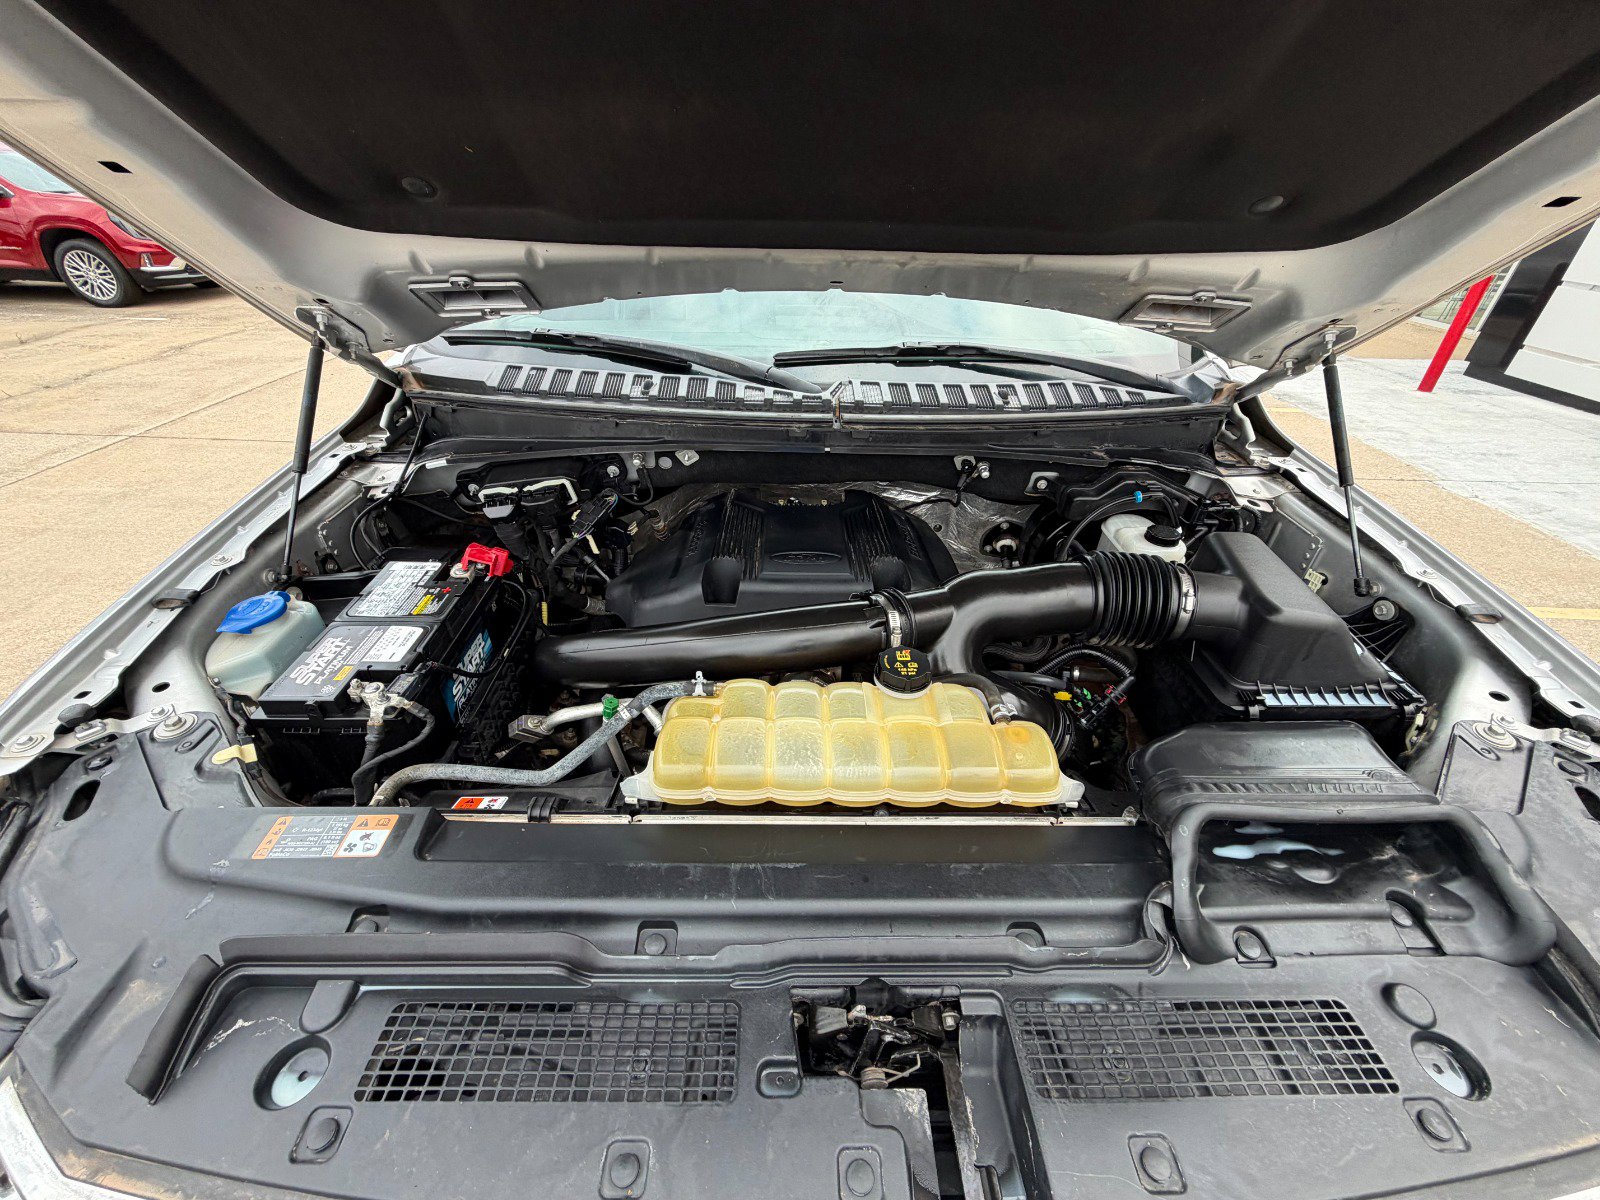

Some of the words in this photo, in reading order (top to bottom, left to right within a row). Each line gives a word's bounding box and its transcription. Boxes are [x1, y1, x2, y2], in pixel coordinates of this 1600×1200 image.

[290, 637, 339, 678] SUPER
[296, 637, 347, 685] START
[314, 646, 353, 684] PLATINUM
